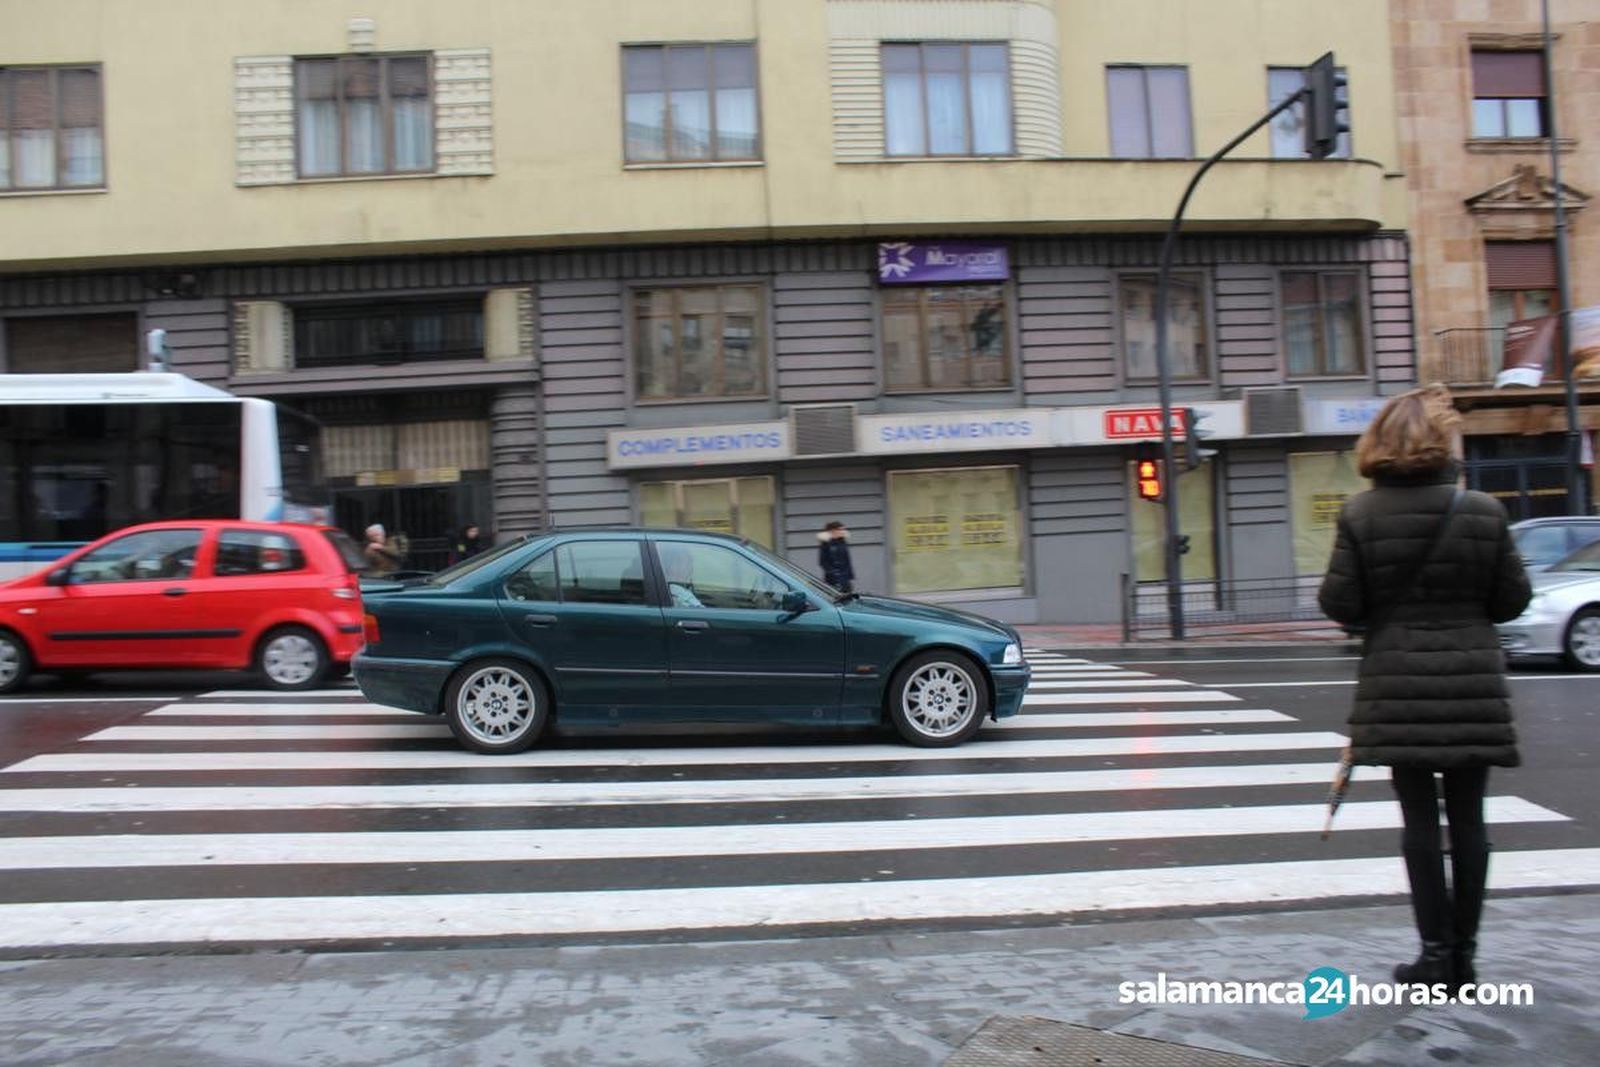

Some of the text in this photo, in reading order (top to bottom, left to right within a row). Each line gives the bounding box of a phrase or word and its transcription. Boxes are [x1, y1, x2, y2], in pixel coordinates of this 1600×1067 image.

[1337, 403, 1377, 423] BAÑ
[881, 420, 1033, 442] SANEAMIENTOS
[617, 432, 783, 457] COMPLEMENTOS
